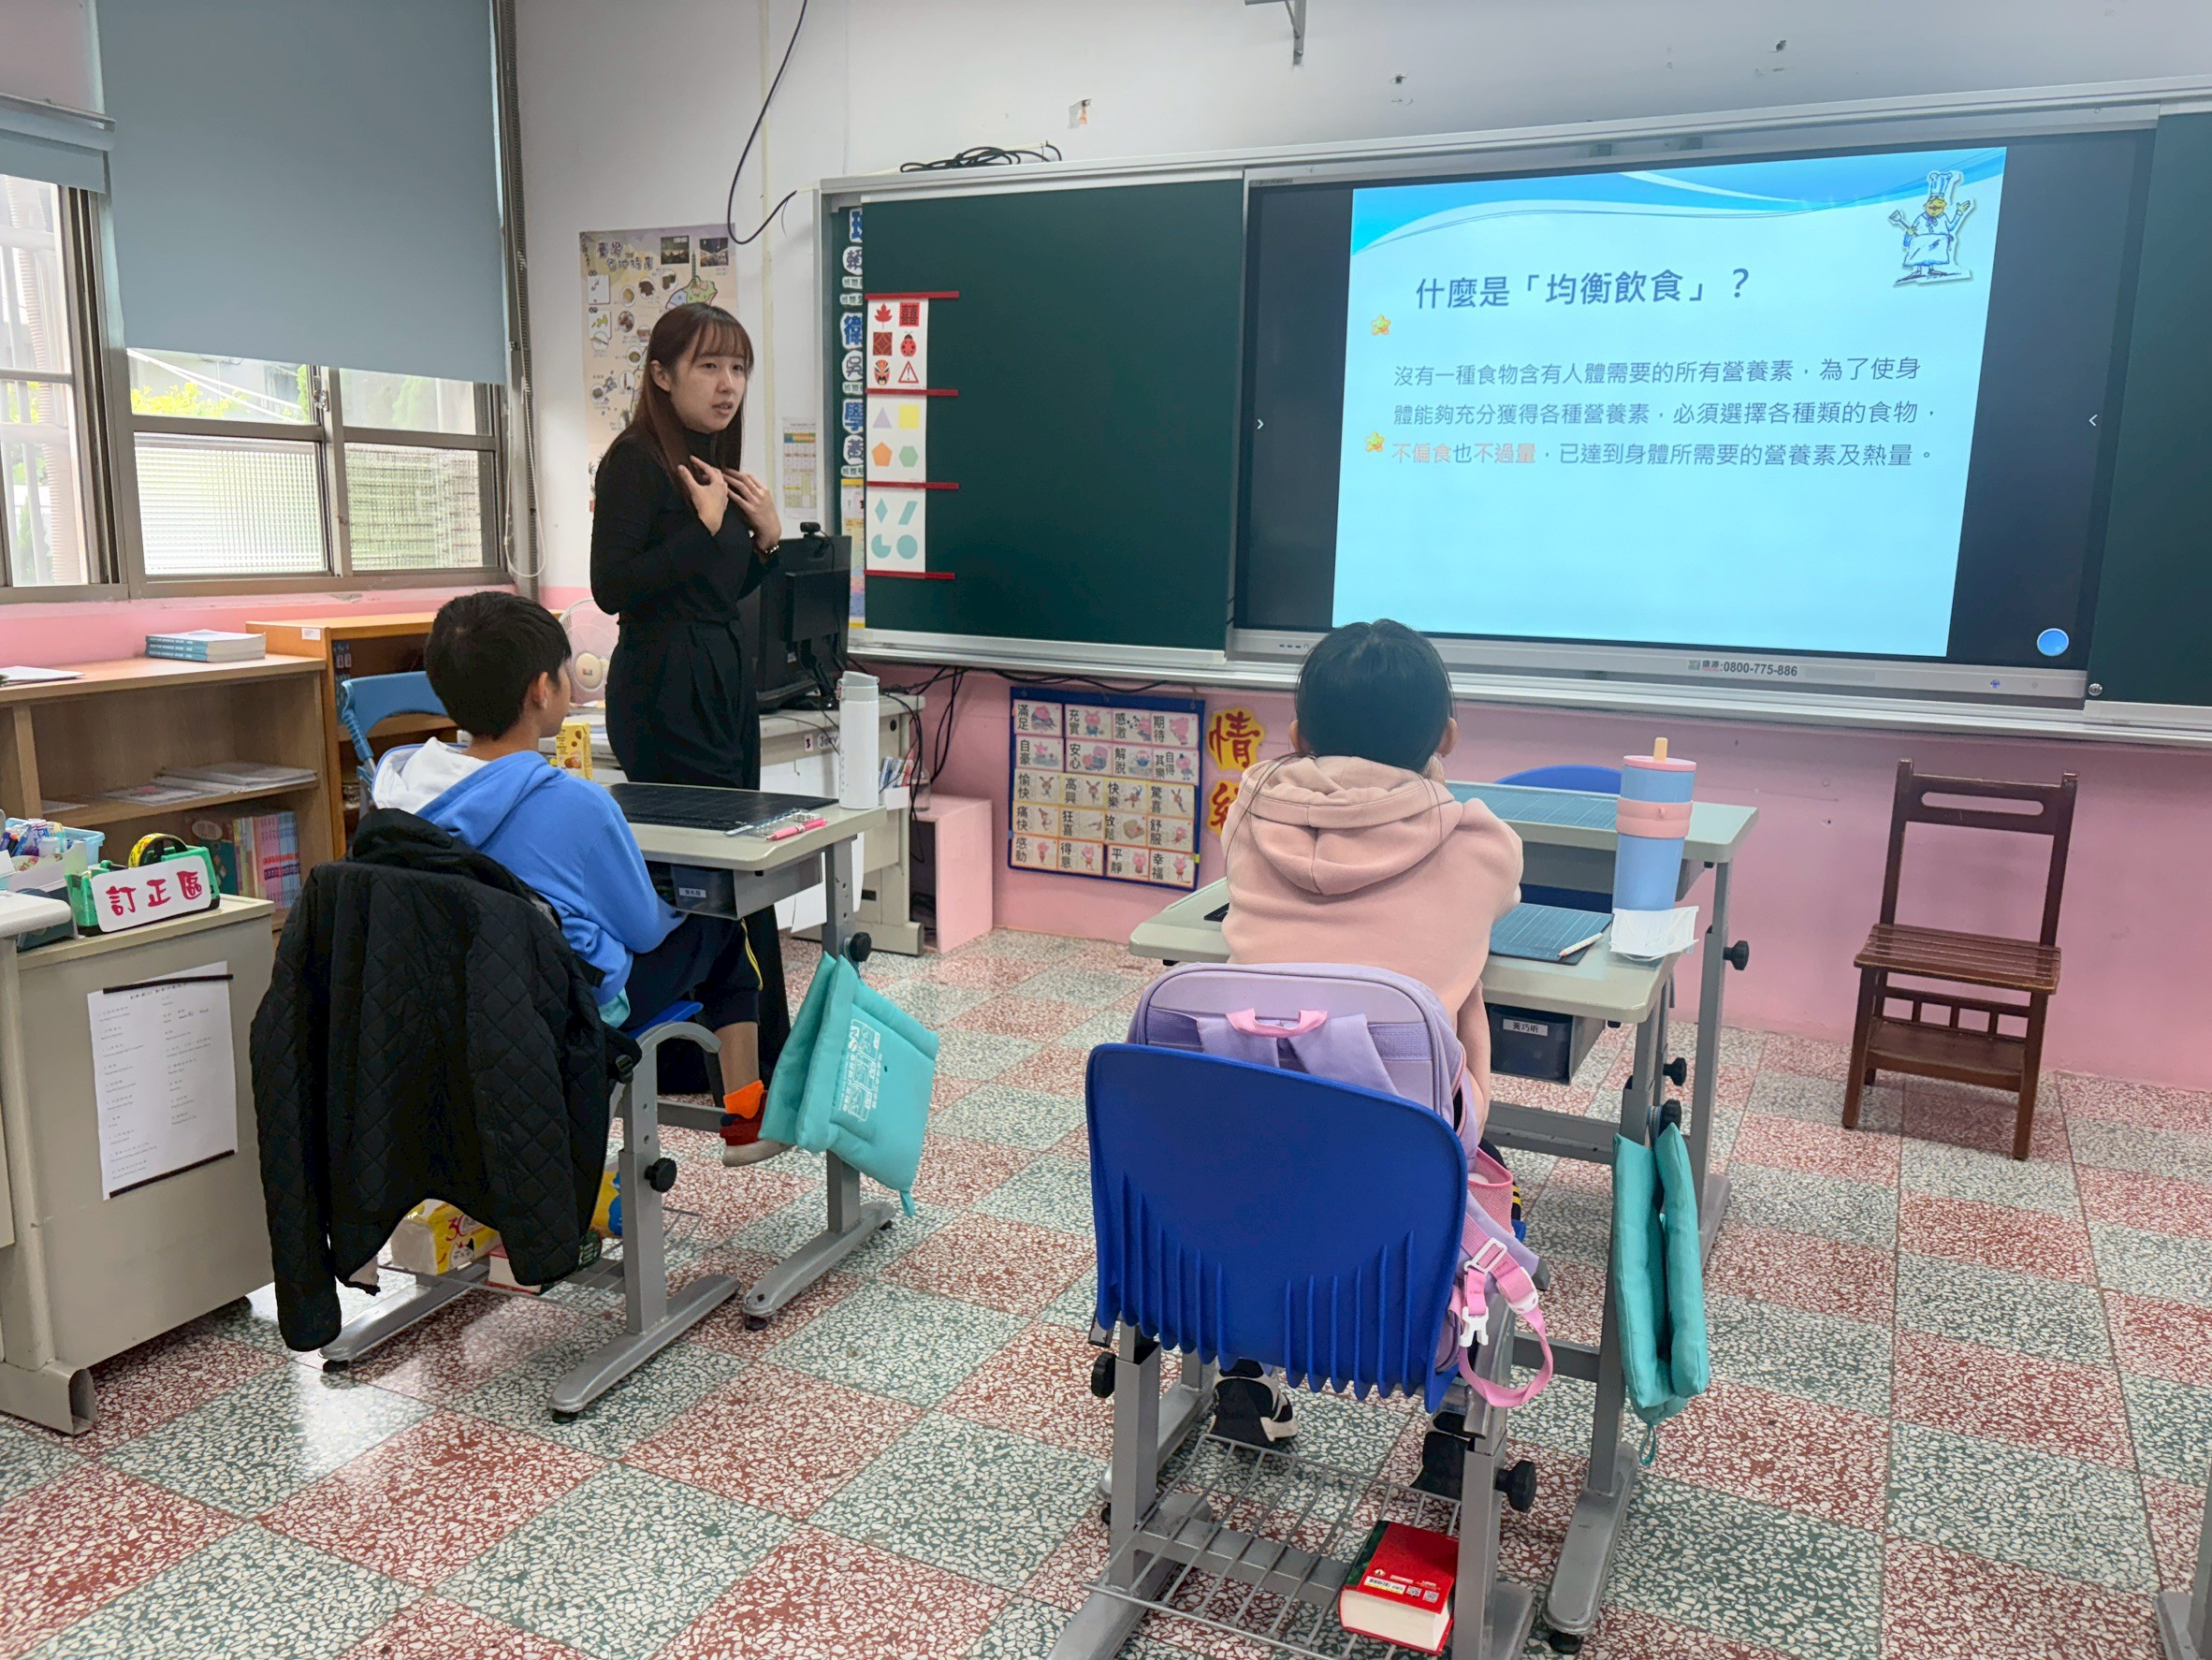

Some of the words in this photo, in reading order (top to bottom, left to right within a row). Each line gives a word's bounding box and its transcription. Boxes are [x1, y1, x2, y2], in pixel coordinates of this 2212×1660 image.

[1416, 268, 1750, 310] 什麼是「均衡飲食」？
[1017, 704, 1029, 731] 滿足
[1069, 708, 1080, 735] 充實
[1114, 712, 1127, 739] 感激
[1153, 715, 1165, 743] 期待
[1019, 739, 1031, 765] 自豪
[1069, 743, 1082, 770] 安心
[1114, 747, 1127, 775] 解脫
[1017, 772, 1030, 799] 愉快
[1065, 778, 1077, 805] 高興
[1107, 781, 1120, 808] 快樂
[1150, 785, 1162, 813] 驚喜
[1016, 806, 1028, 832] 痛快
[1062, 809, 1074, 837] 狂喜
[1149, 818, 1162, 846] 舒服
[1015, 837, 1027, 863] 感動
[1111, 848, 1123, 875] 平靜
[1152, 852, 1164, 881] 幸福
[105, 870, 203, 917] 訂正區
